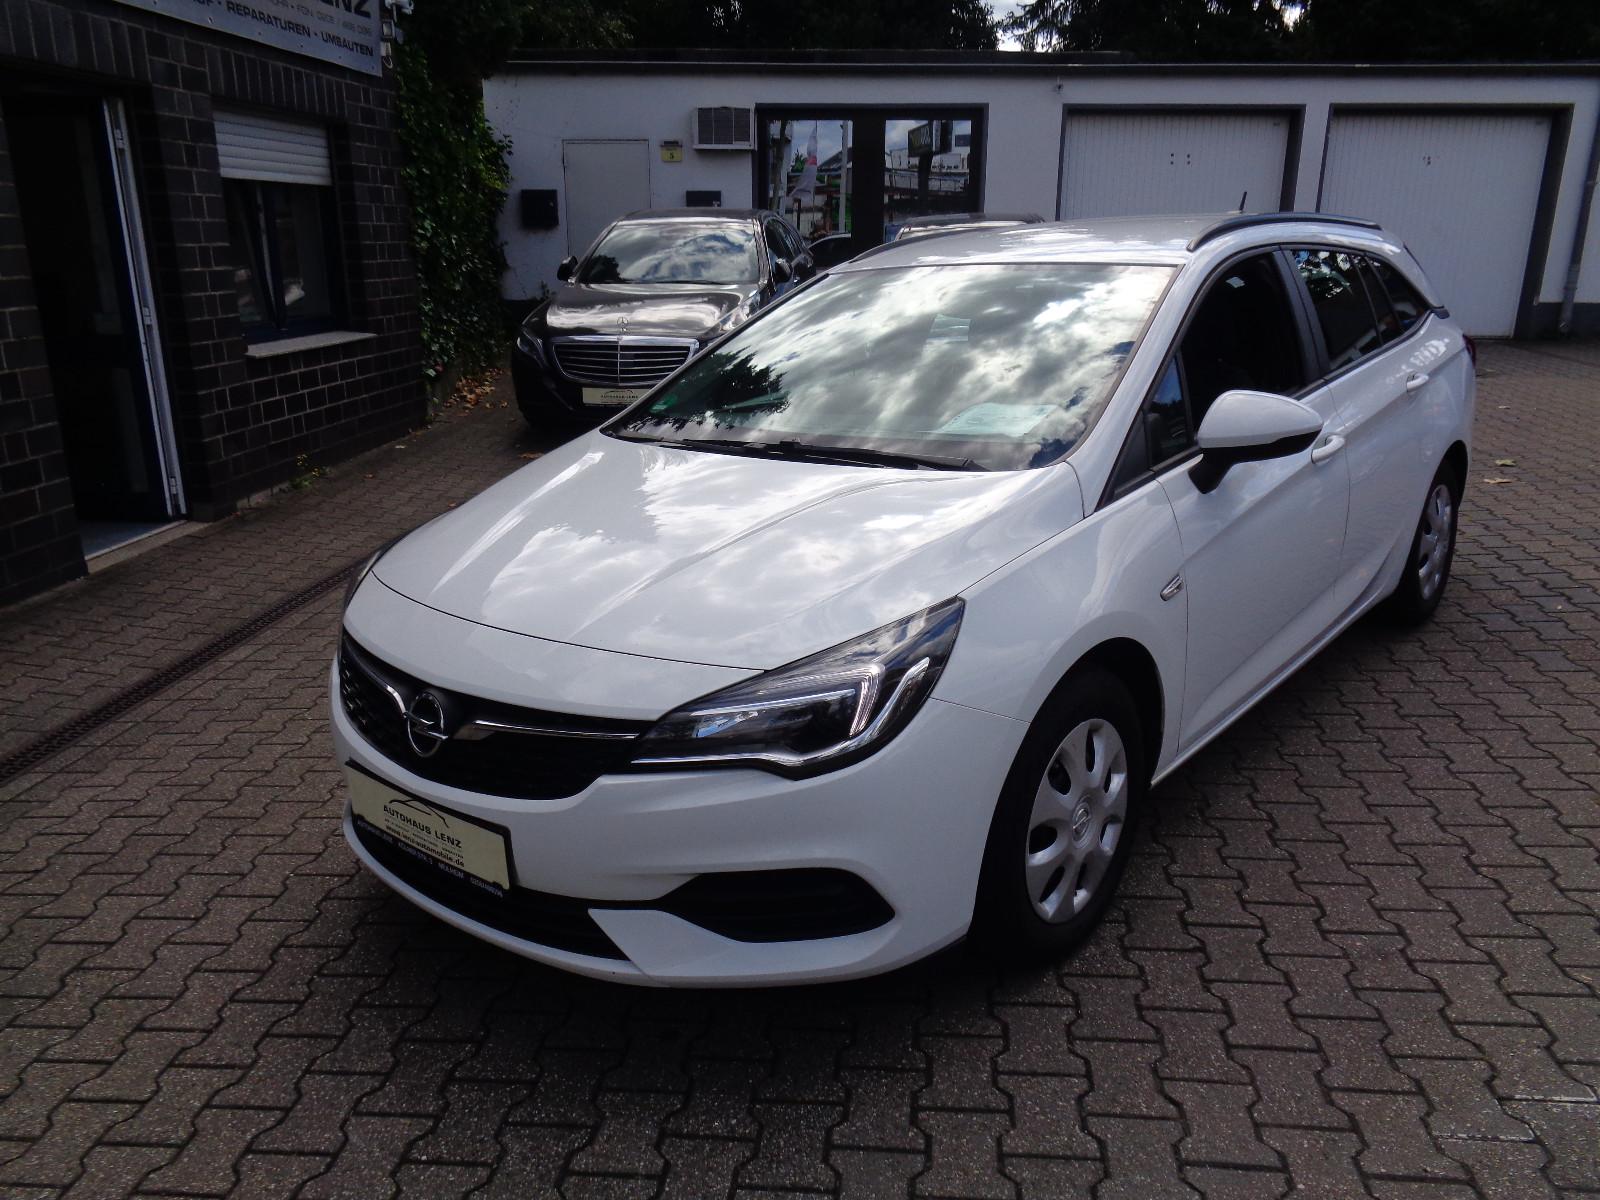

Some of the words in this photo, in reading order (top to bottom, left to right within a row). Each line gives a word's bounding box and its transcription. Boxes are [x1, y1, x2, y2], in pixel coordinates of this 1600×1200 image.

[226, 1, 311, 38] REPARATUREN
[321, 31, 374, 57] UMBAUTEN
[383, 804, 431, 835] AUTOHAUS
[435, 830, 462, 849] LENZ
